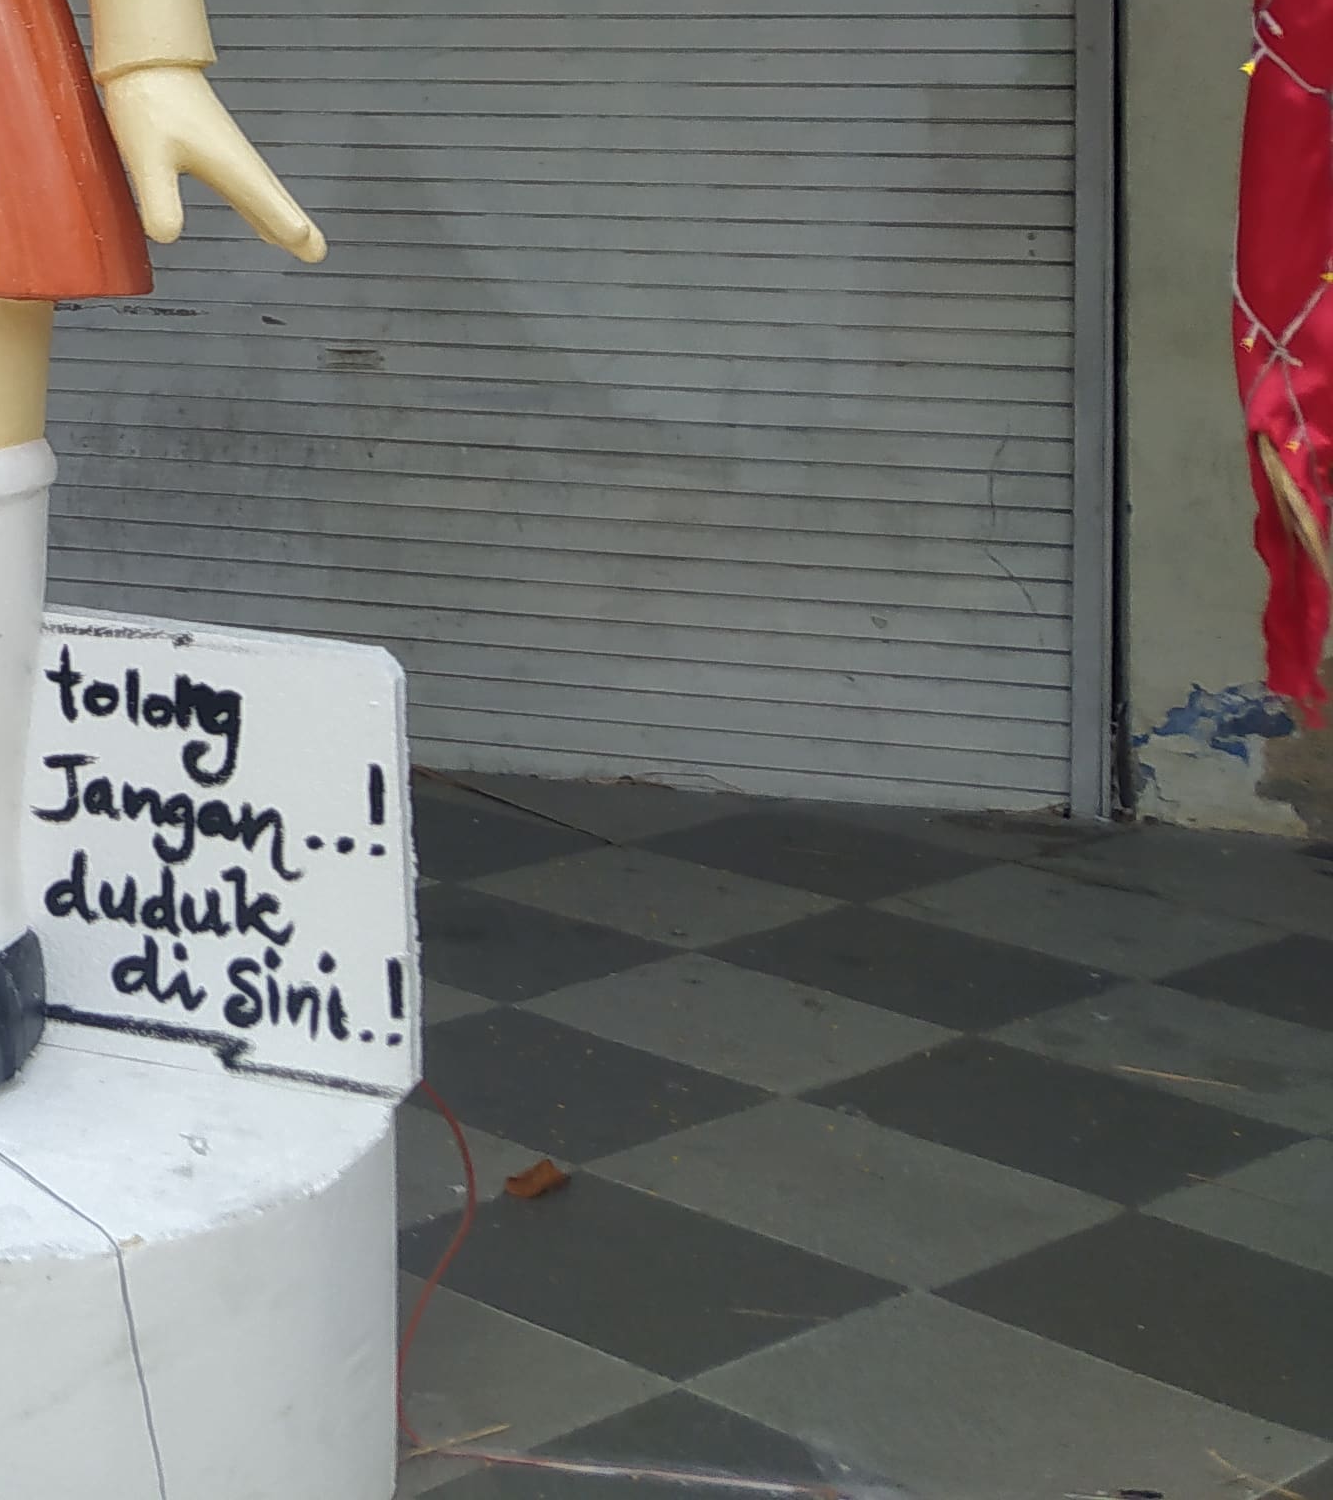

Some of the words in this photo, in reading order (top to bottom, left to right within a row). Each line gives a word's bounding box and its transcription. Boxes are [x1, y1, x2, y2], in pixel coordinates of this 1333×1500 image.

[44, 644, 242, 787] tolong
[44, 849, 294, 946] duduk
[112, 934, 207, 1011] di
